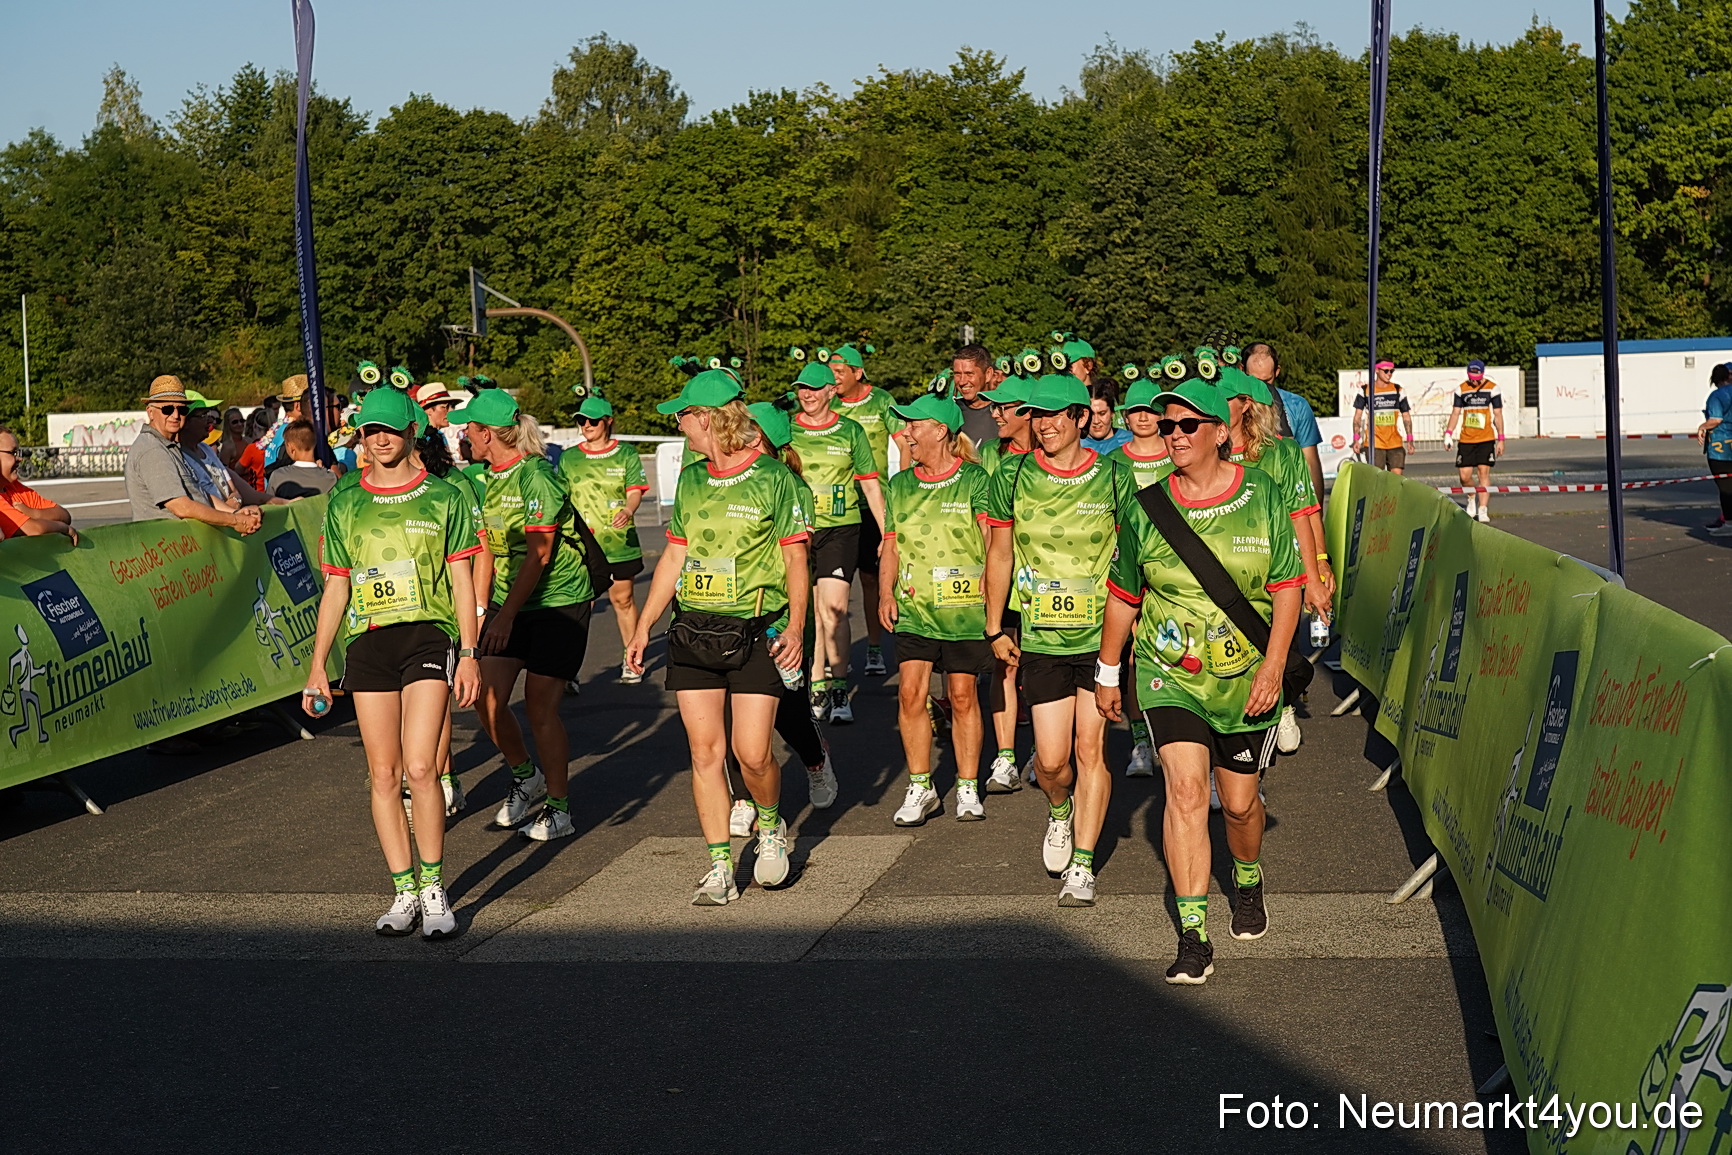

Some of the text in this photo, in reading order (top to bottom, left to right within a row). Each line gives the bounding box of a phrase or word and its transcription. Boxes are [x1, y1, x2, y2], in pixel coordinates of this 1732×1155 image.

[372, 484, 430, 505] MONSTERSTARK
[1187, 488, 1254, 520] MONSTERSTARK
[109, 535, 202, 585] Gesunde Firmen
[278, 552, 303, 572] Fischer
[373, 580, 396, 599] 88
[408, 579, 417, 602] 2022
[695, 574, 713, 590] 87
[952, 580, 971, 594] 92
[46, 595, 81, 618] Fischer
[356, 588, 365, 612] WALK
[1052, 595, 1075, 612] 86
[46, 616, 152, 710] firmenlauf
[1214, 656, 1242, 668] Lorusso
[55, 693, 106, 733] neumarkt
[1545, 700, 1567, 728] Fischer
